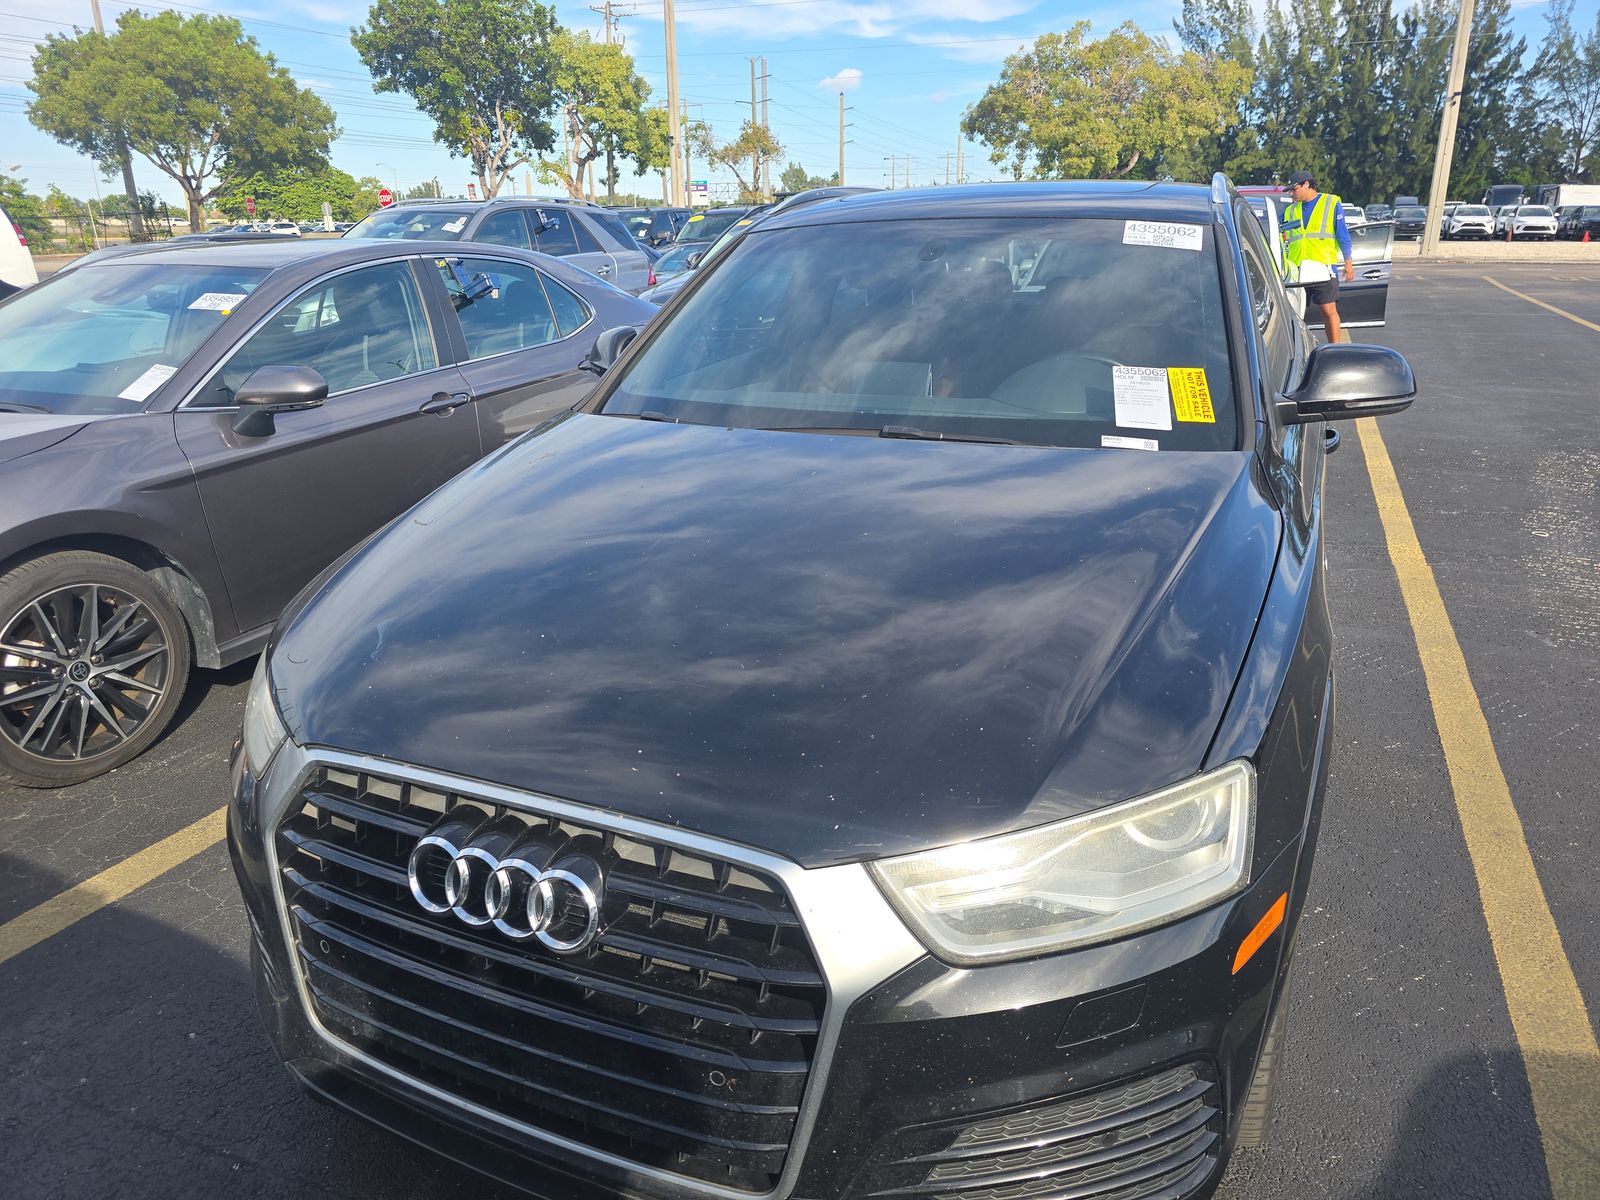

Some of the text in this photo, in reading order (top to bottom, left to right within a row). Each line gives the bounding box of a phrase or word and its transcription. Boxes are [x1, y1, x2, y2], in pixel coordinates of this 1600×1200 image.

[379, 195, 391, 203] STOP
[1127, 223, 1197, 238] 4355062
[1115, 367, 1166, 377] 4355062
[1186, 372, 1194, 385] NOT
[1189, 386, 1198, 399] FOR
[1194, 371, 1212, 419] THIS VEHICLE
[1192, 400, 1202, 418] SALE
